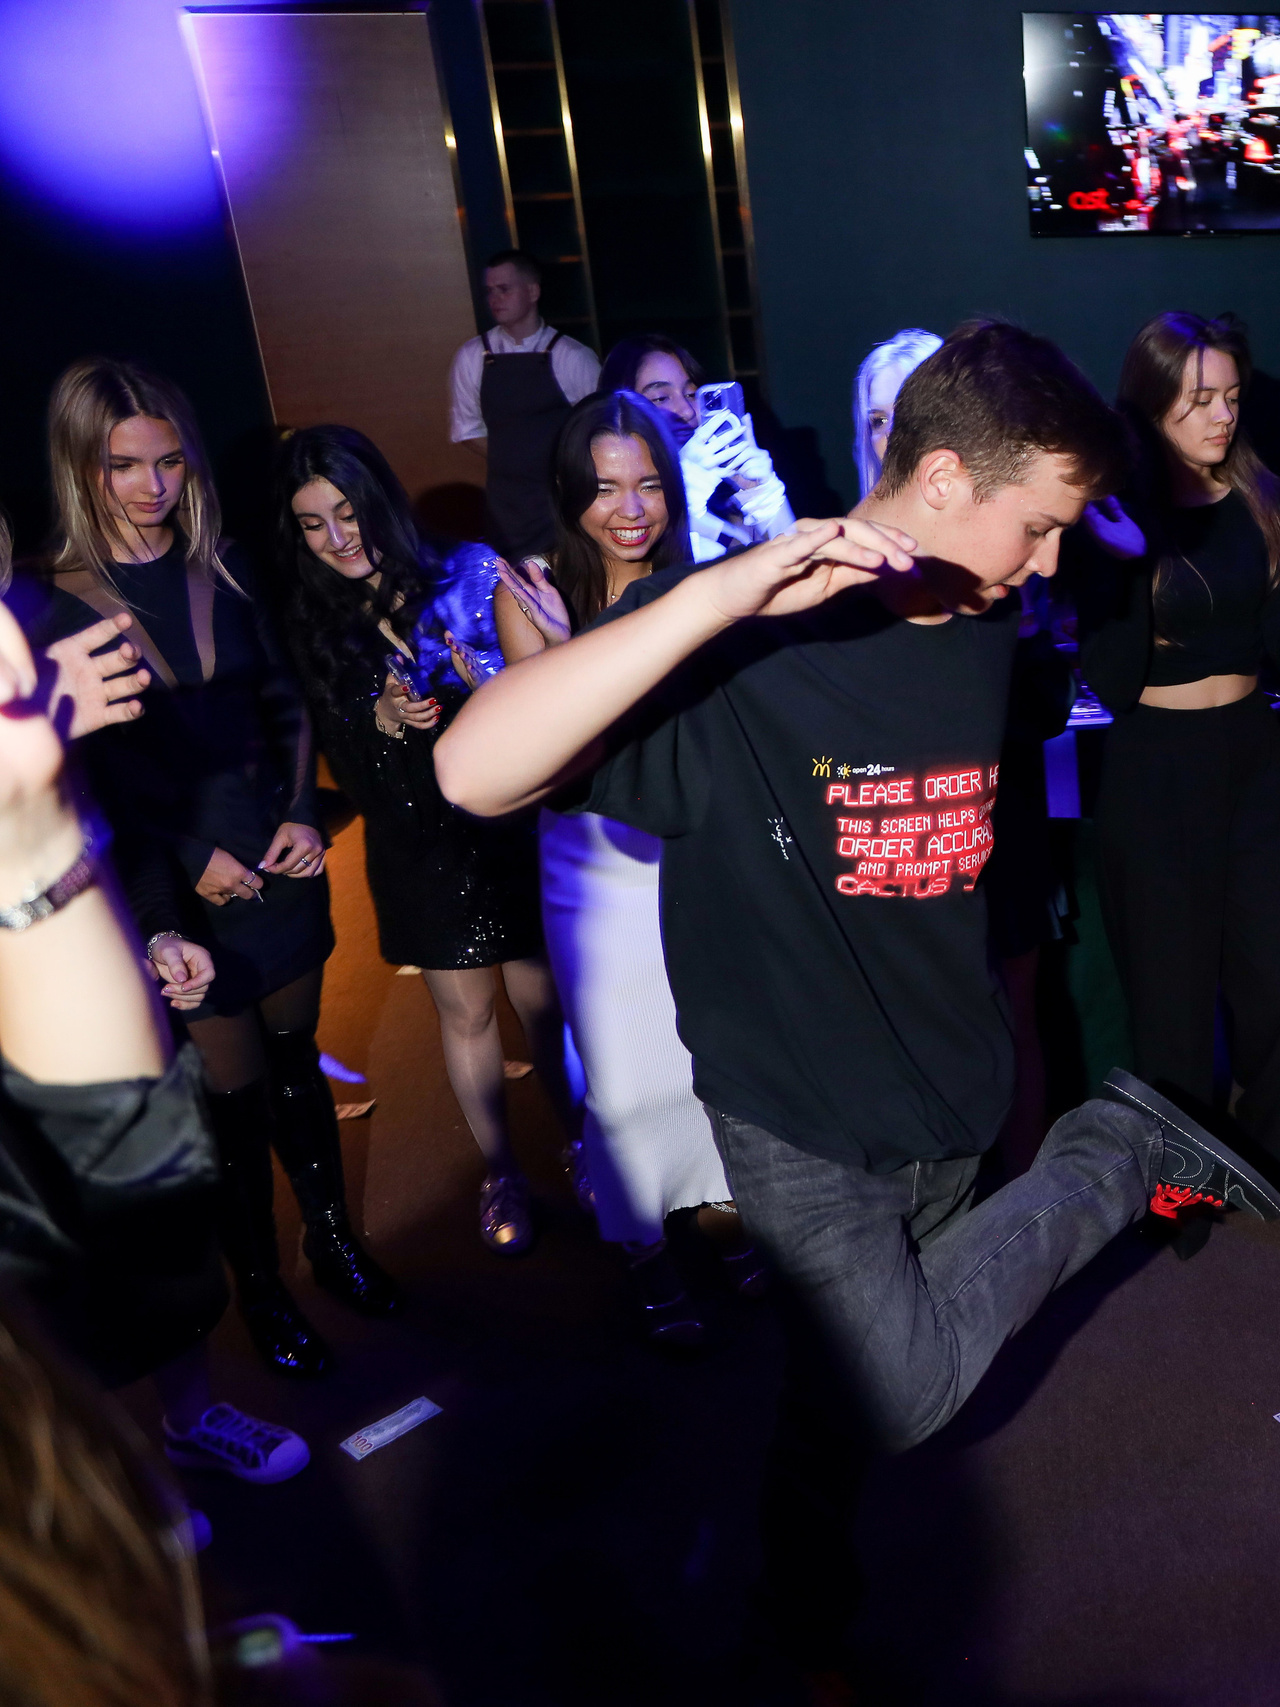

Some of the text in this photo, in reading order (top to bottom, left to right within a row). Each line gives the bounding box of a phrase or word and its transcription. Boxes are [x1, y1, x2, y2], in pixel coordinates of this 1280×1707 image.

[852, 766, 867, 775] open
[866, 763, 881, 776] 24
[828, 781, 913, 805] PLEASE
[925, 771, 982, 800] ORDER
[837, 809, 976, 834] THIS SCREEN HELPS
[839, 837, 914, 858] ORDER
[857, 861, 887, 876] AND
[895, 860, 951, 877] PROMPT
[351, 1435, 374, 1452] 100
